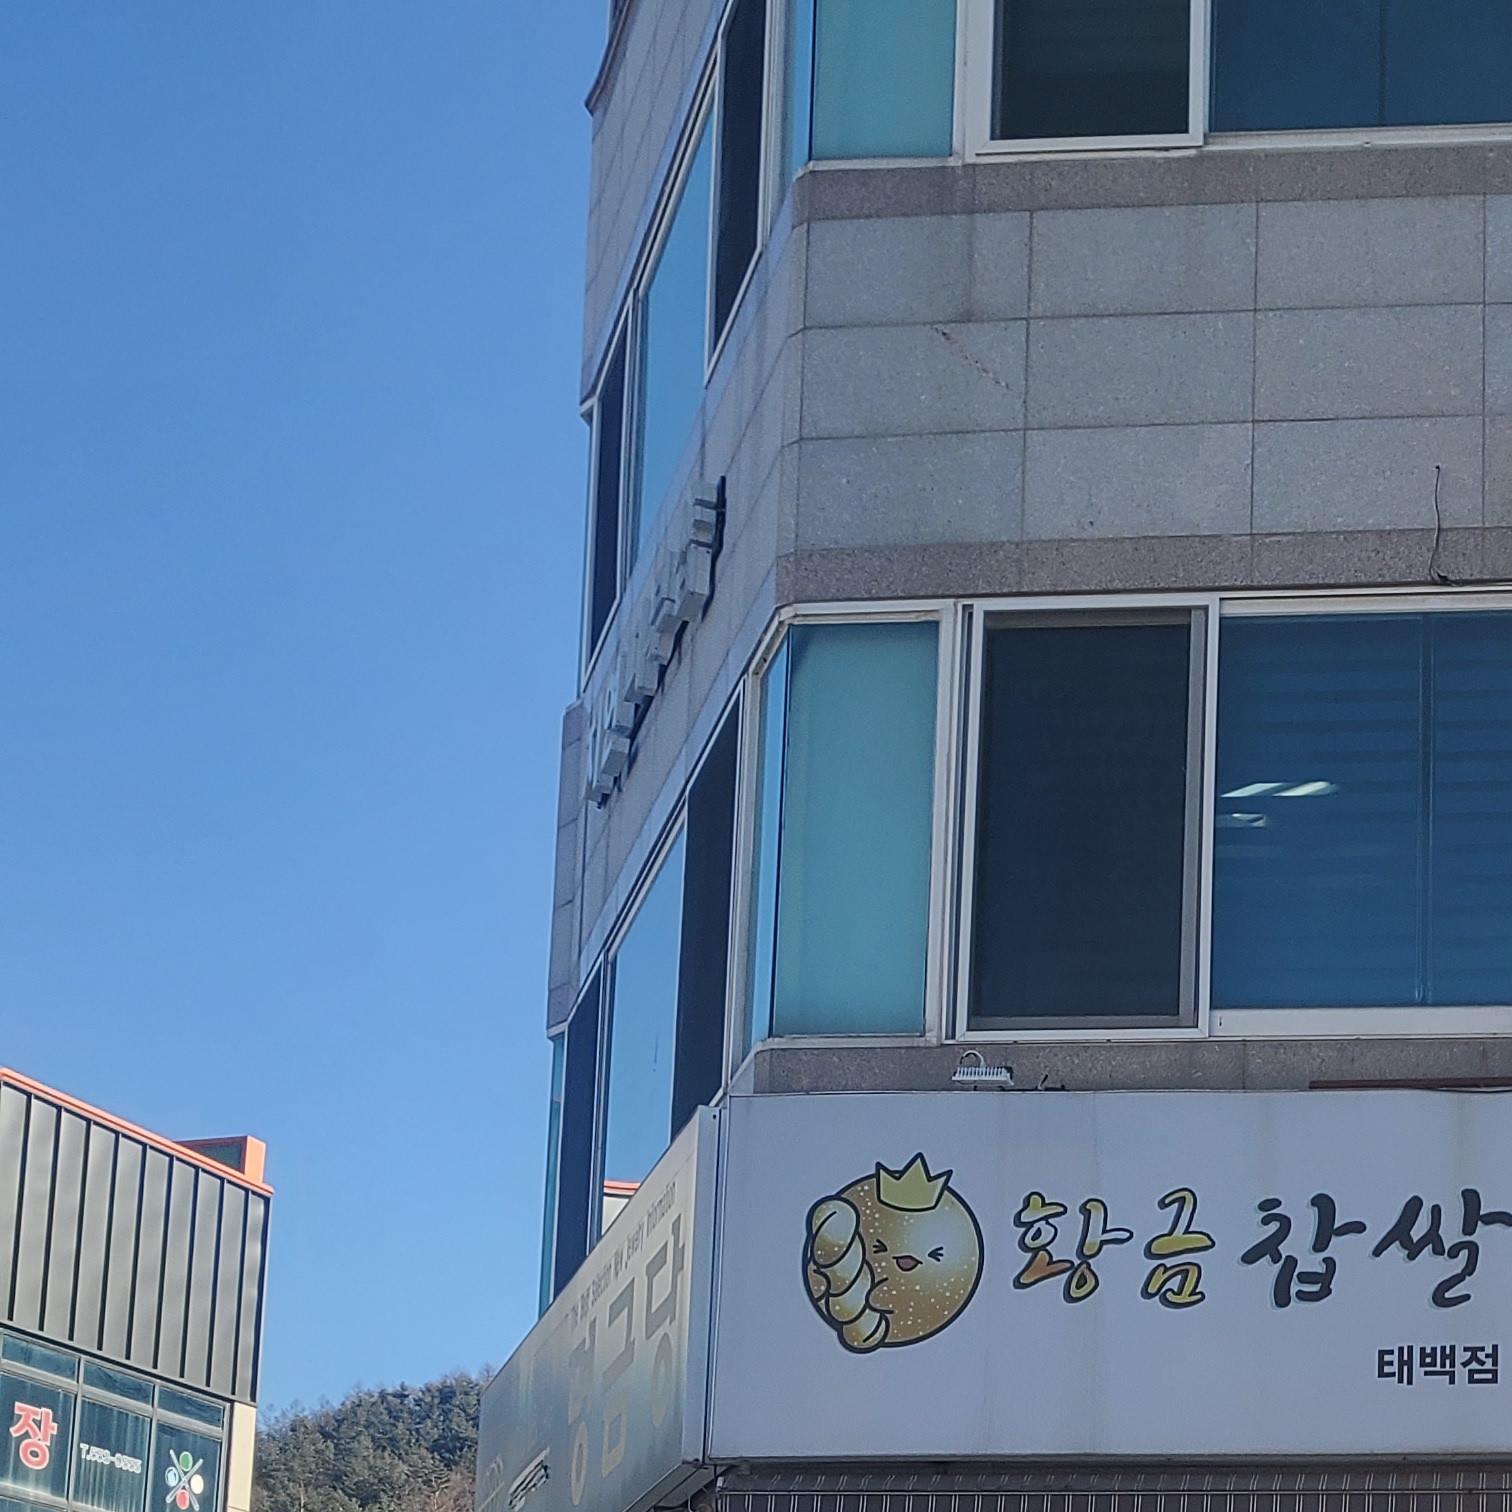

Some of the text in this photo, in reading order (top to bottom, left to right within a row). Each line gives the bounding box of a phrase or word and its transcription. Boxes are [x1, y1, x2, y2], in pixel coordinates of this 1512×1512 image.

[1013, 1190, 1216, 1308] 황금
[1377, 1344, 1500, 1386] 태백점
[11, 1402, 57, 1470] 장
